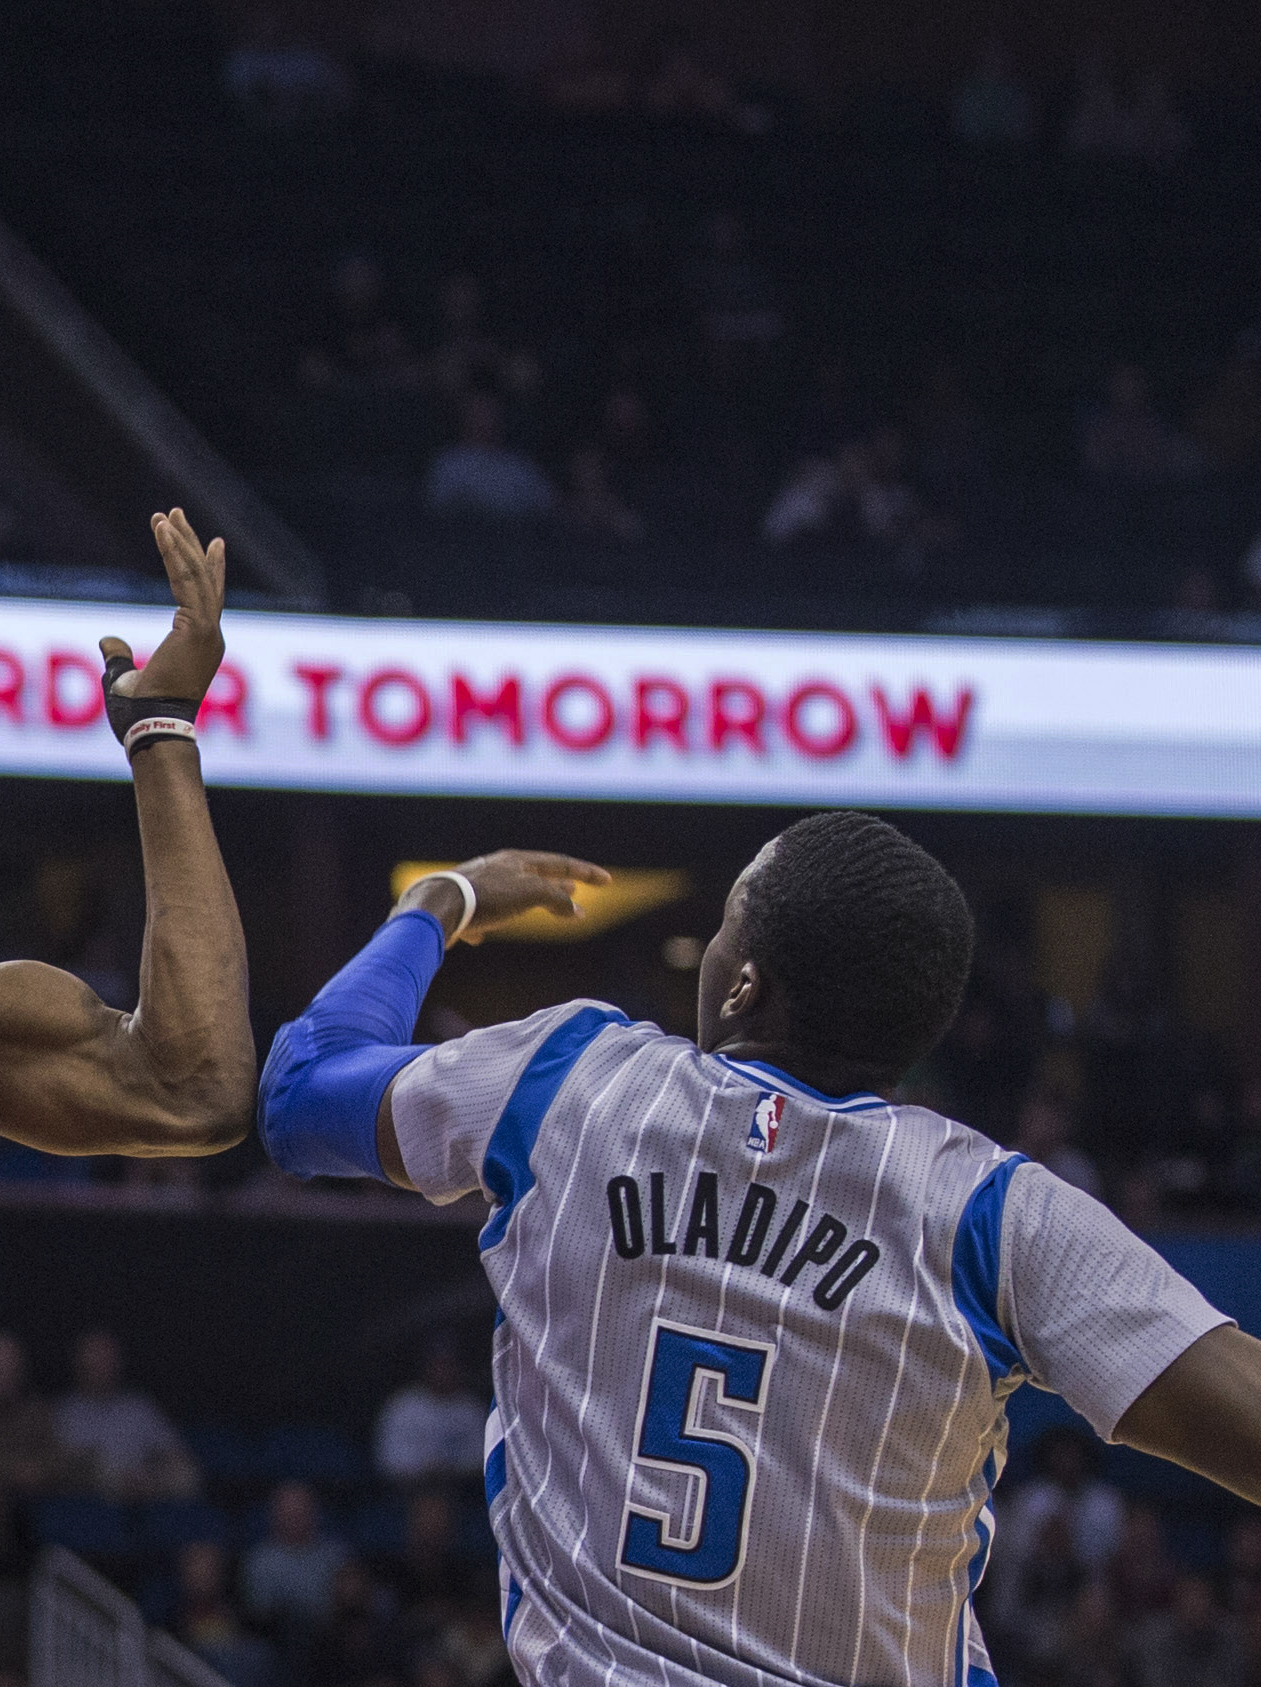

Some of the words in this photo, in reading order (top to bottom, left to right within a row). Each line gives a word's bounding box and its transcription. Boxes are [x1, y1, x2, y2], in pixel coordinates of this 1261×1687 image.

[153, 721, 176, 729] First
[291, 660, 979, 765] TOMORROW
[748, 1137, 765, 1149] NBA
[606, 1171, 881, 1312] OLADIPO
[616, 1317, 777, 1591] 5
